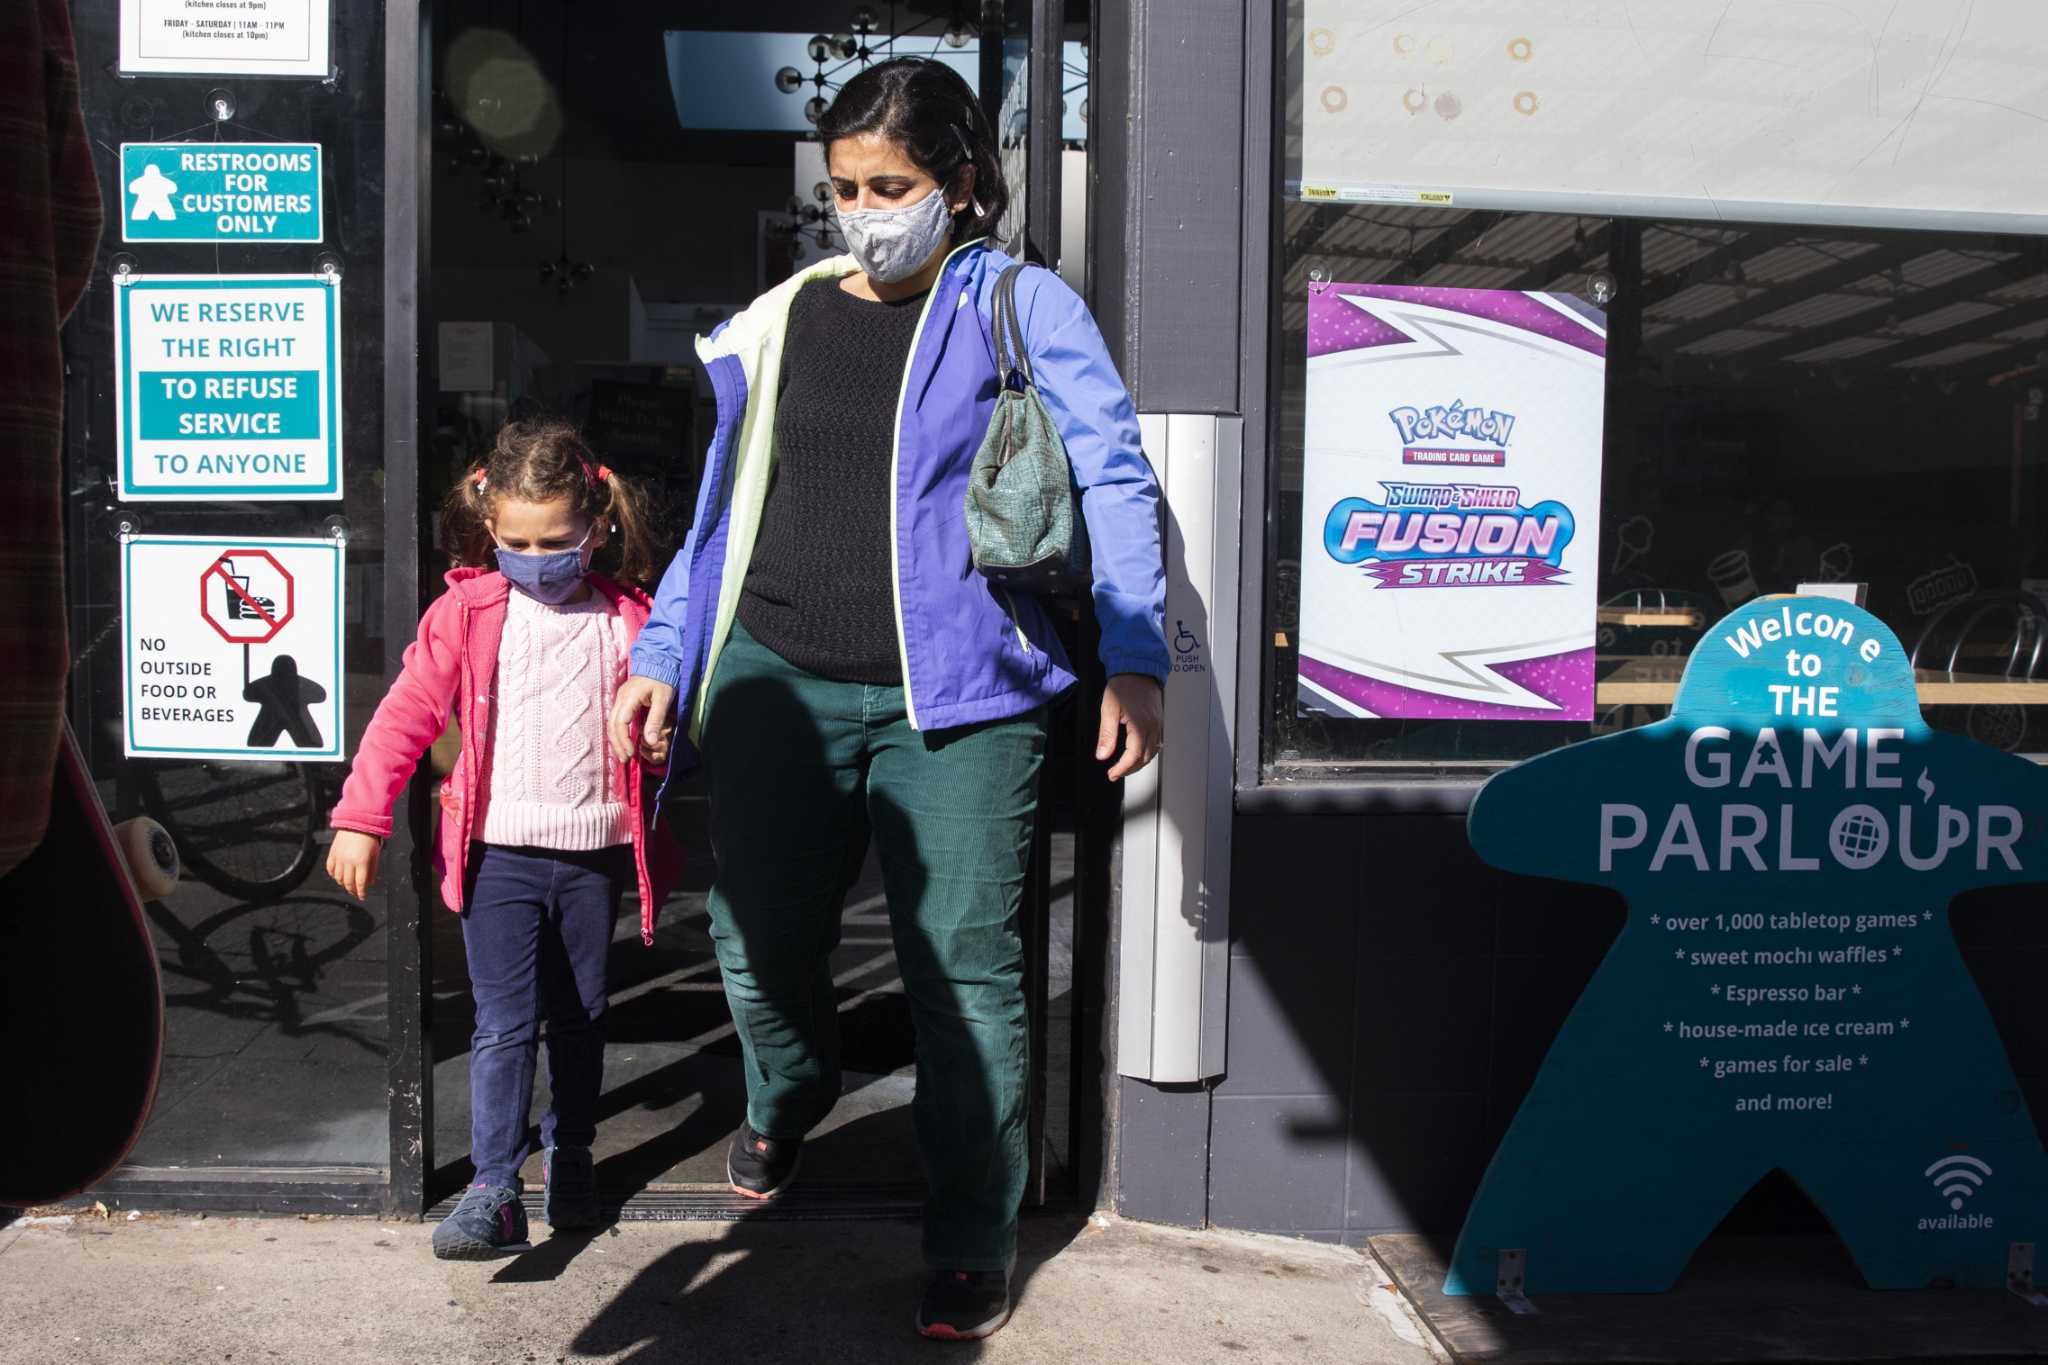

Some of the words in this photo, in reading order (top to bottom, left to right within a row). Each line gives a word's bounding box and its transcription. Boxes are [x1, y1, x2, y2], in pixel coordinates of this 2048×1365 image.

[164, 19, 189, 28] FRIDAY
[196, 20, 231, 28] SATURDAY
[239, 20, 258, 29] 11AM
[265, 22, 285, 30] 11PM
[182, 30, 212, 39] (kitchen
[213, 31, 236, 39] closes
[246, 32, 268, 40] 10pm)
[181, 153, 312, 172] RESTROOMS
[225, 174, 268, 192] FOR
[182, 194, 311, 214] CUSTOMERS
[216, 215, 278, 233] ONLY
[150, 303, 190, 322] WE
[198, 302, 305, 322] RESERVE
[161, 338, 210, 358] THE
[218, 337, 296, 357] RIGHT
[161, 378, 197, 400] TO
[204, 377, 298, 400] REFUSE
[178, 413, 281, 435] SERVICE
[154, 454, 189, 474] TO
[196, 453, 307, 474] ANYONE
[1412, 450, 1448, 463] TRADING
[1449, 451, 1471, 464] CARD
[1472, 452, 1496, 464] GAME
[1339, 511, 1560, 556] FUSION
[1398, 560, 1529, 585] STRIKE
[140, 638, 166, 652] NO
[140, 661, 212, 676] OUTSIDE
[1175, 654, 1200, 664] PUSH
[1182, 663, 1206, 673] OPEN
[1785, 649, 1822, 678] to
[141, 684, 188, 698] FOOD
[193, 685, 217, 700] OR
[1768, 684, 1840, 717] THE
[141, 707, 235, 723] BEVERAGES
[1684, 726, 1905, 790] GAME
[1599, 803, 2024, 873] PARLOUR
[1666, 915, 1709, 931] over
[1714, 913, 1764, 933] 1,000
[1769, 912, 1851, 933] tabletop
[1855, 912, 1918, 933] games
[1690, 950, 1749, 966] sweet
[1818, 946, 1888, 964] waffles
[1726, 985, 1809, 1006] Espresso
[1814, 984, 1847, 1001] bar
[1679, 1020, 1798, 1039] house-made
[1835, 1019, 1895, 1036] cream
[1714, 1057, 1777, 1078] games
[1783, 1055, 1810, 1073] for
[1815, 1055, 1853, 1072] sale
[1735, 1094, 1772, 1111] and
[1777, 1093, 1833, 1111] more!
[1917, 1214, 1994, 1230] available
